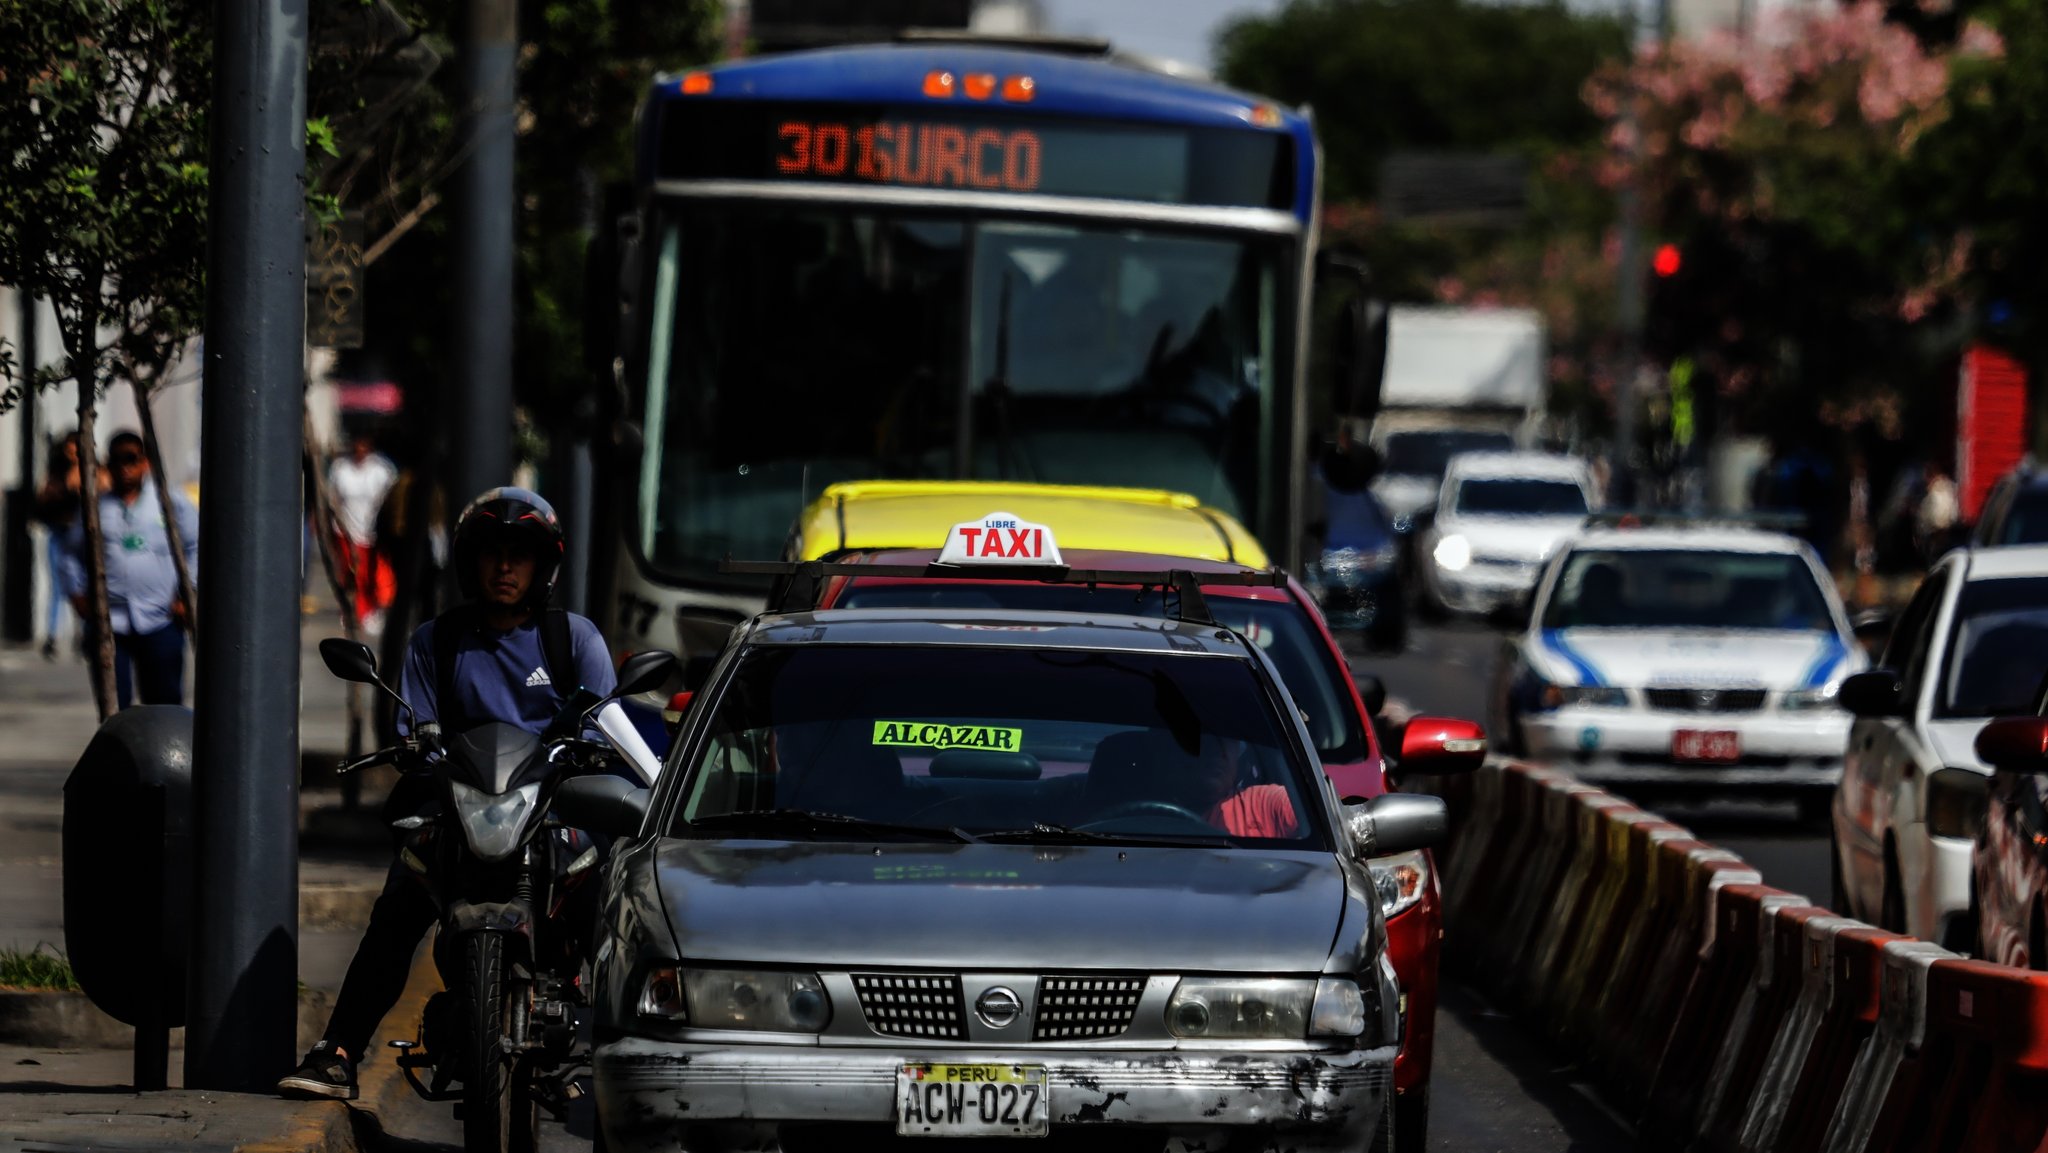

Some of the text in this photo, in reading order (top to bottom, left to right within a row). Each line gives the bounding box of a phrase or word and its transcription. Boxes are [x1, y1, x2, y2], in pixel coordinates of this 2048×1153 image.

[777, 121, 1042, 192] 301 SURCO
[985, 520, 1016, 528] LIBRE
[959, 528, 1042, 557] TAXI
[879, 723, 1013, 749] ALCAZAR
[946, 1067, 998, 1082] PERU
[904, 1082, 1040, 1124] ACW-027
